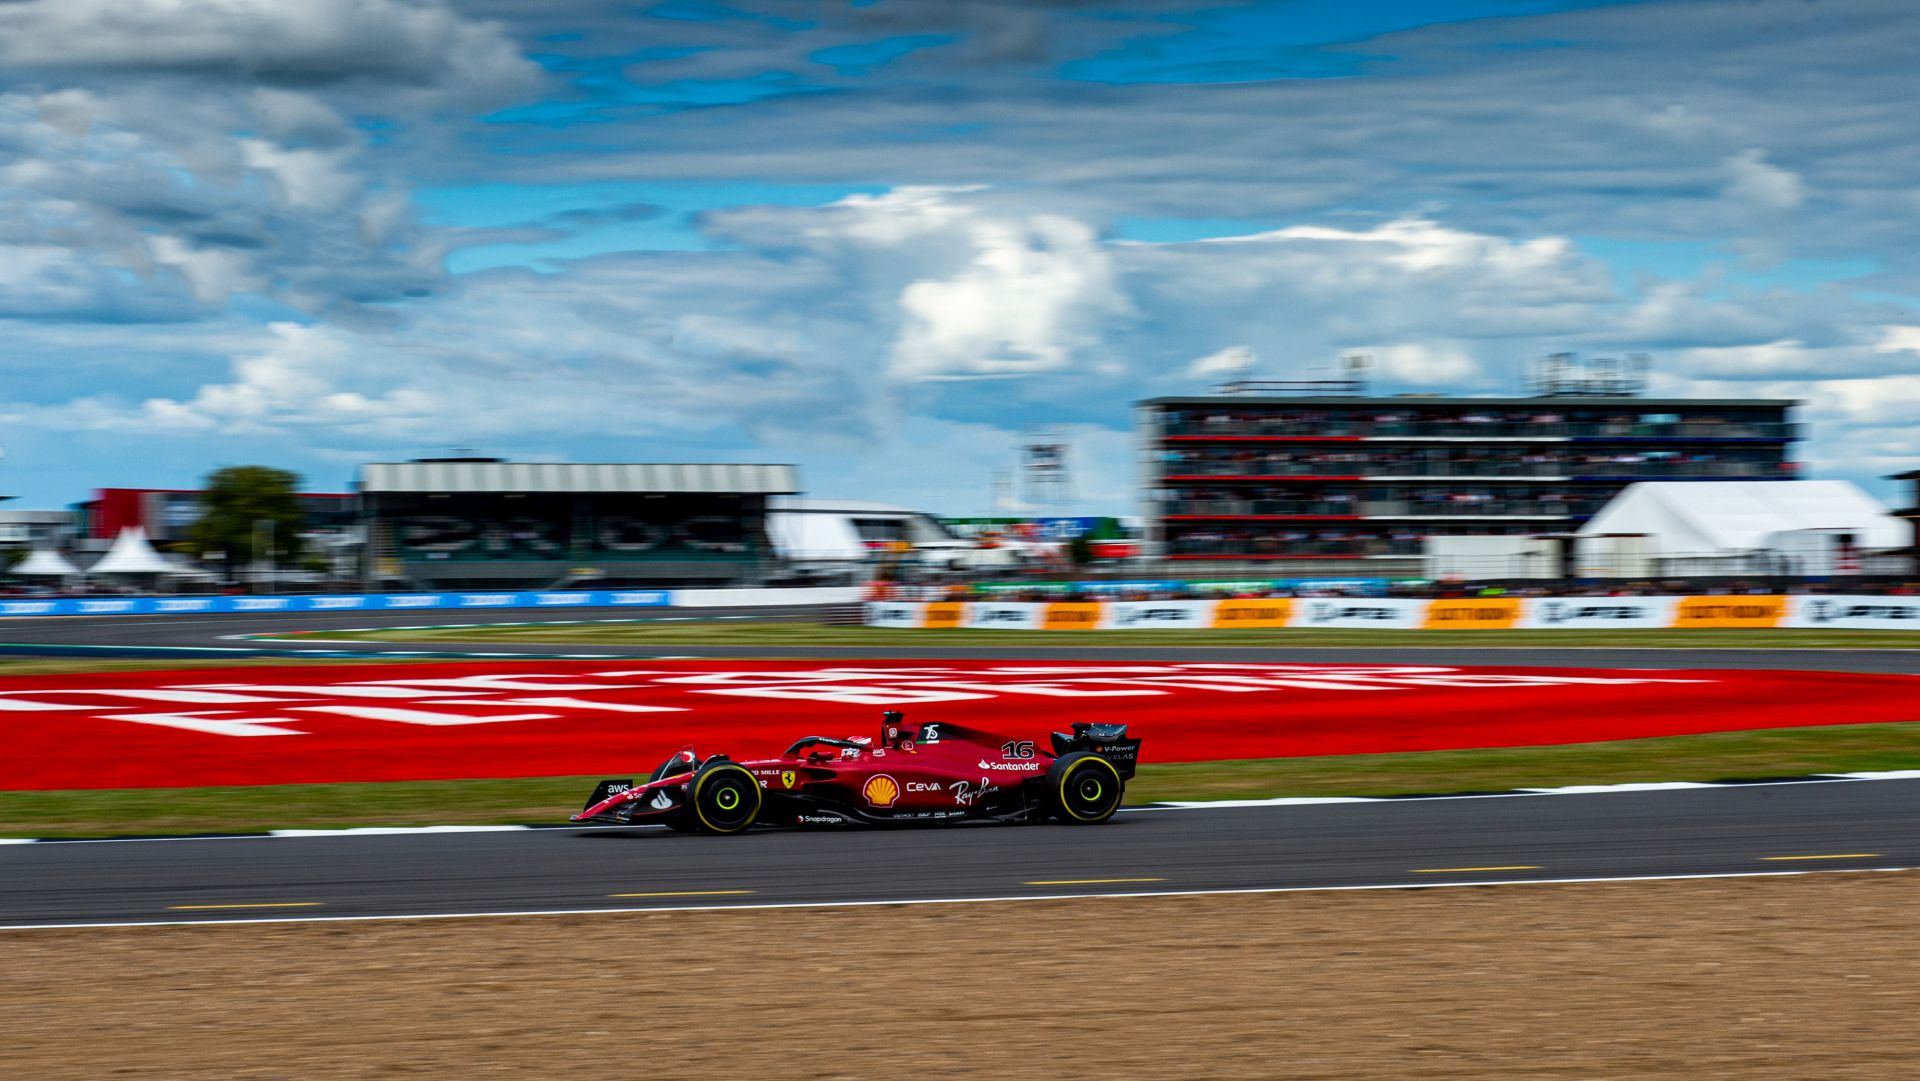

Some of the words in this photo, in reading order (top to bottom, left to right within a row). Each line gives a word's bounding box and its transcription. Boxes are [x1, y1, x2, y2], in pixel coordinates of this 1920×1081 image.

[93, 695, 692, 737] FLY
[688, 672, 1710, 704] BETTER
[1001, 740, 1034, 760] 16
[989, 761, 1039, 771] Santander
[607, 784, 629, 793] aws
[948, 776, 999, 805] Ray-Ban
[804, 815, 842, 824] Snapdragon
